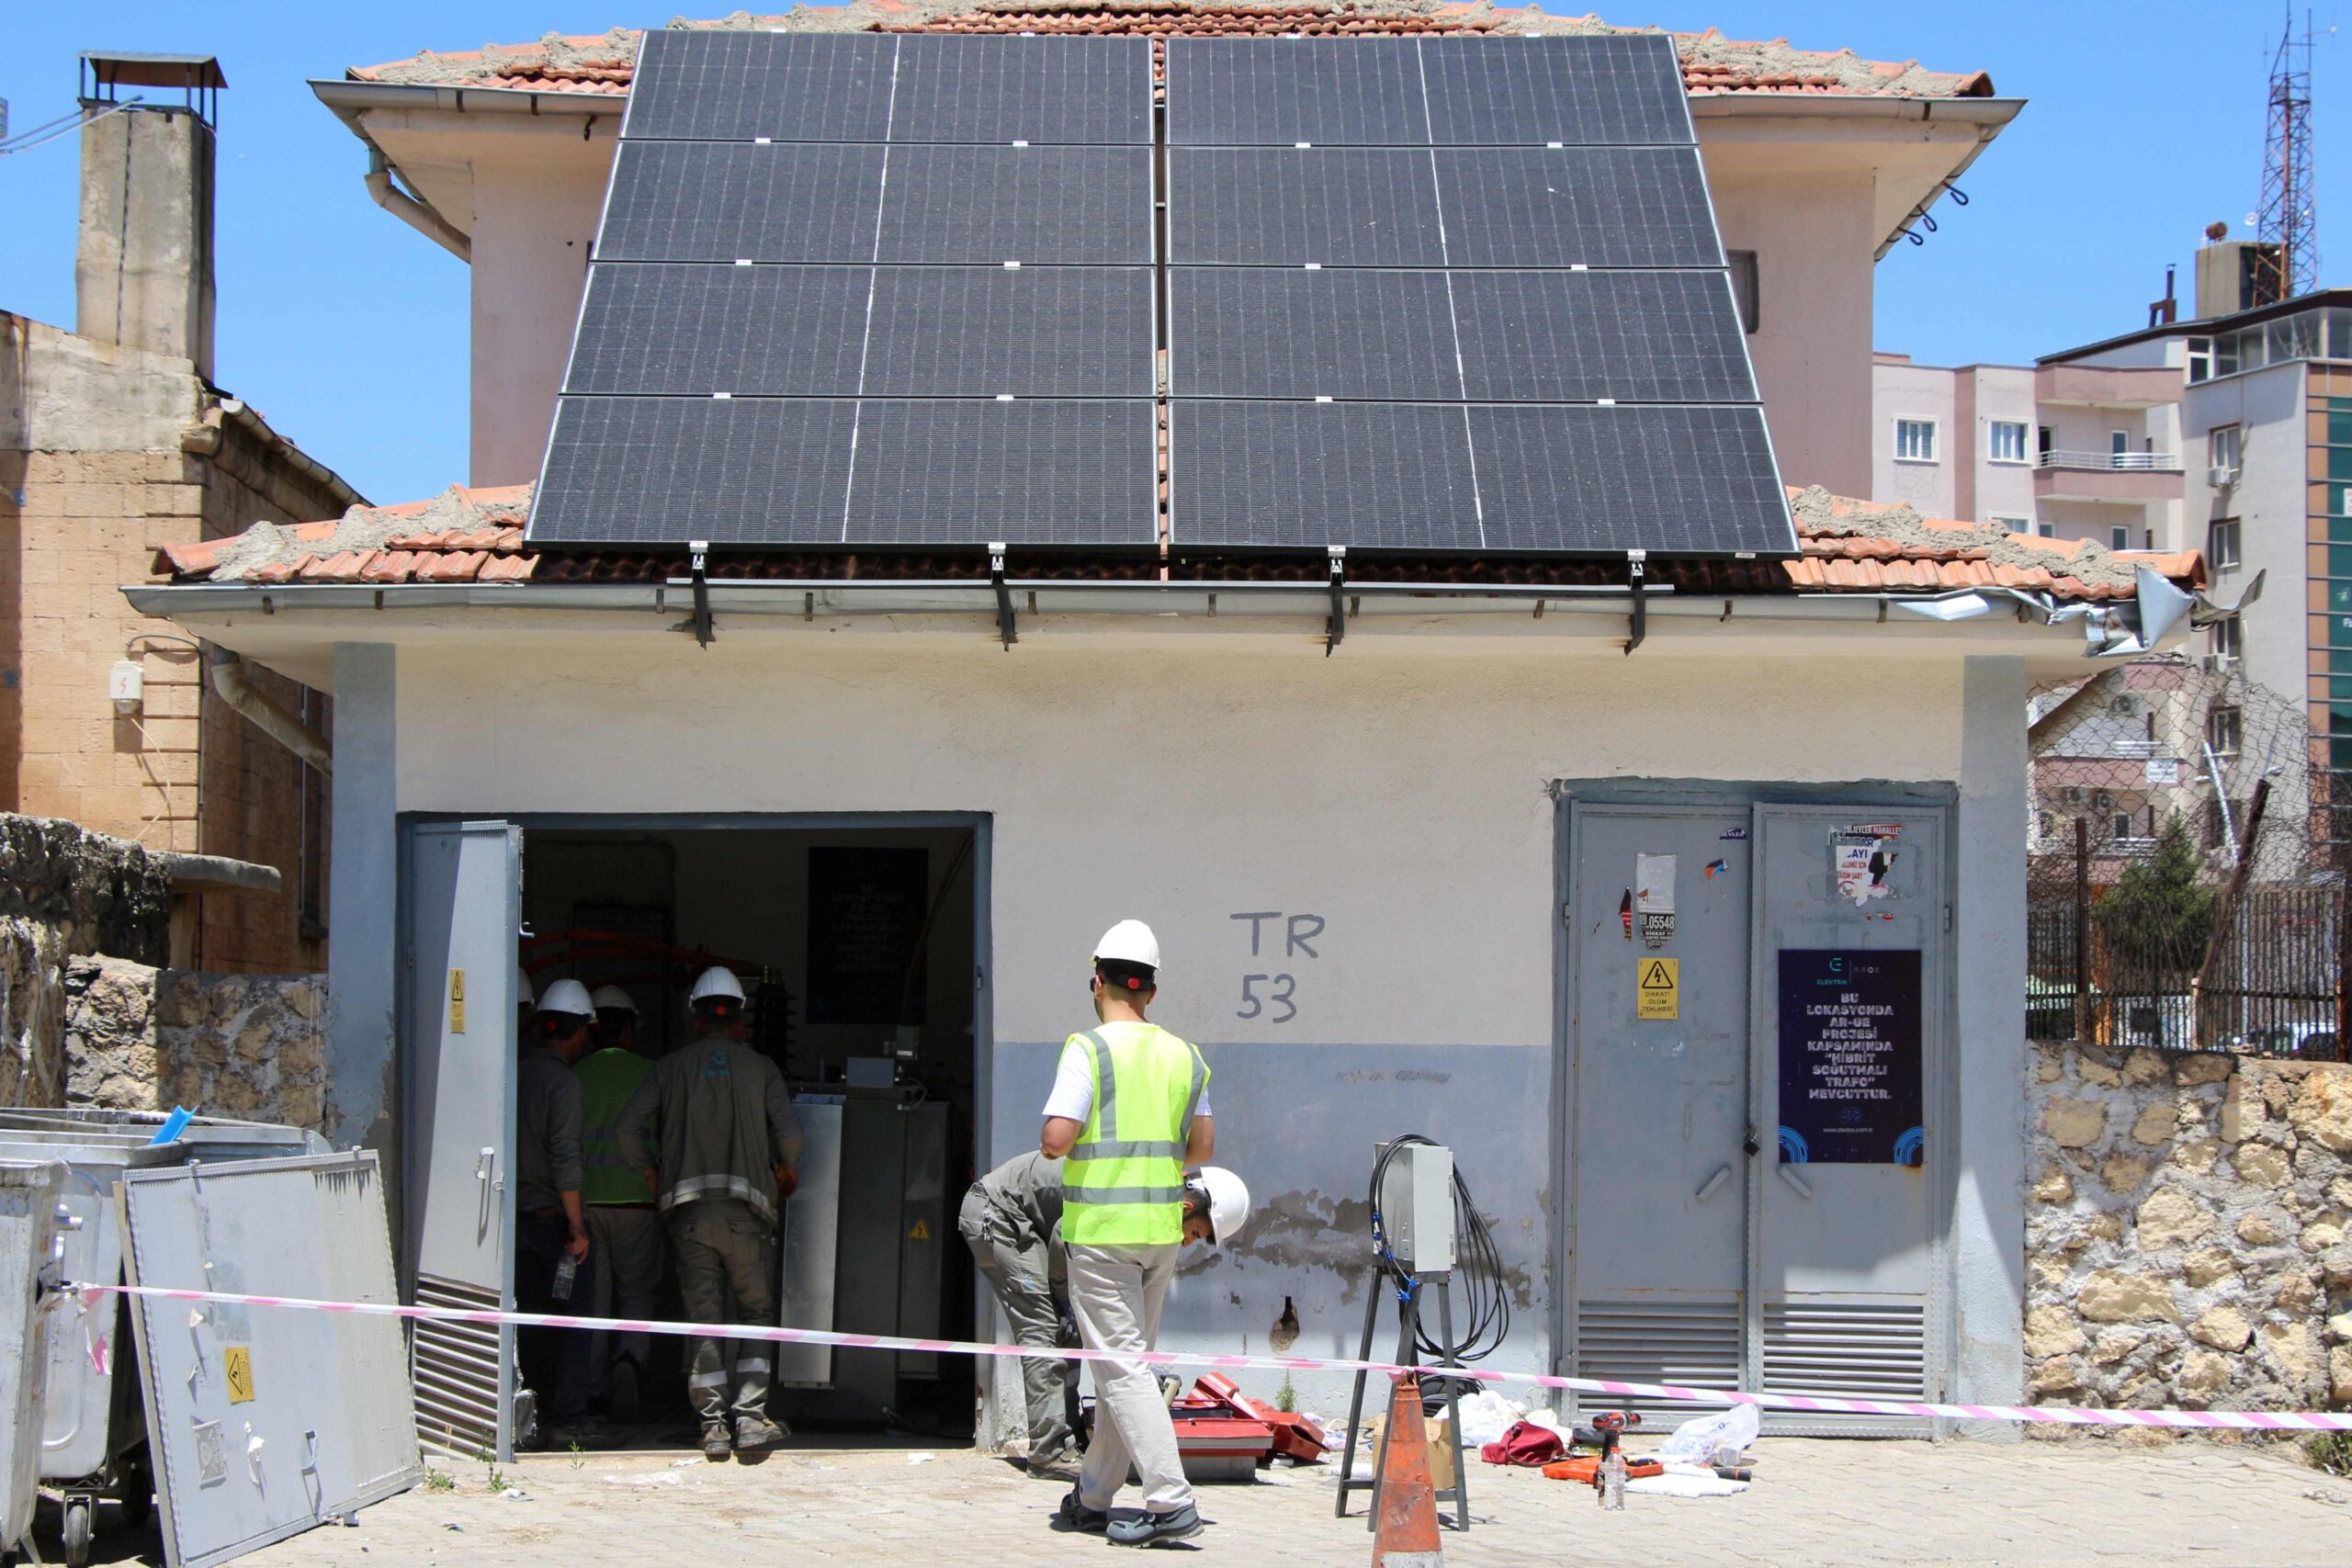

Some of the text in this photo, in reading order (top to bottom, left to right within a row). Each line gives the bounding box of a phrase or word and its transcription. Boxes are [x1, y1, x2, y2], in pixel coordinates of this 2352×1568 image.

[1848, 849, 1868, 859] AYI
[1229, 911, 1325, 958] TR
[1237, 974, 1297, 1023] 53
[1840, 993, 1860, 1003] BU
[1806, 1005, 1894, 1016] LOKASYONDA
[1822, 1027, 1878, 1039] PROJESİ
[1807, 1041, 1894, 1051] KAPSAMINDA
